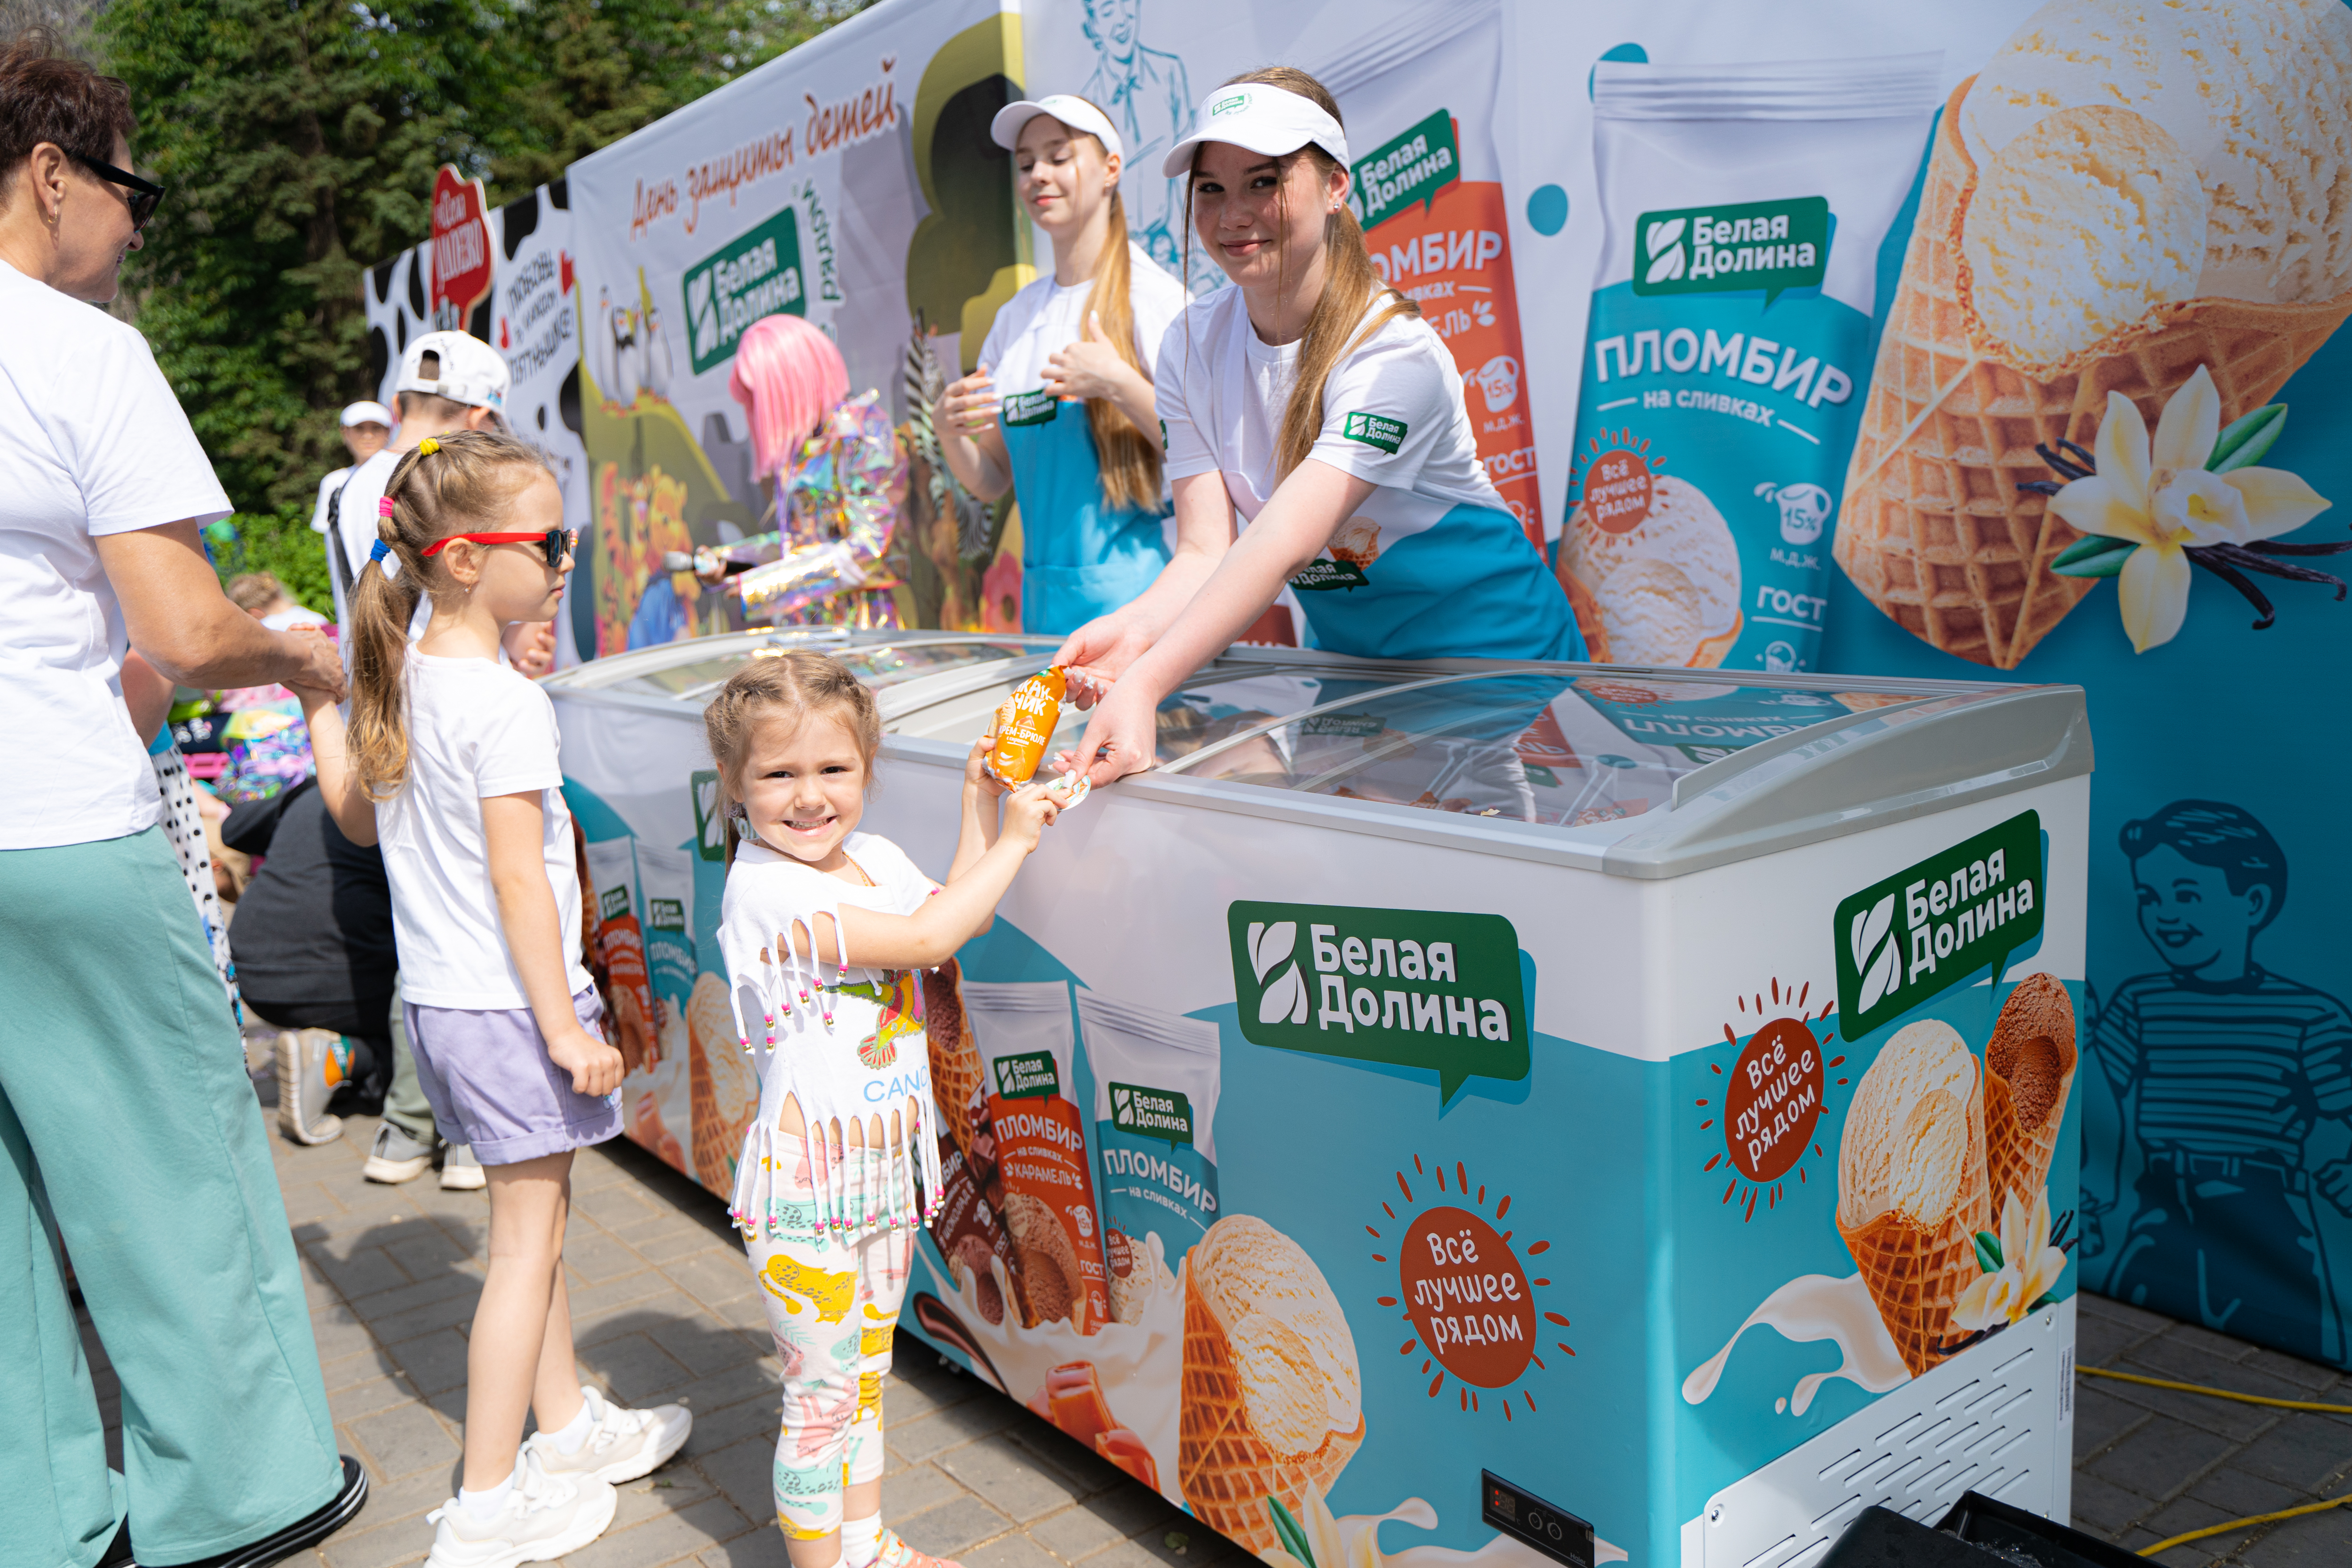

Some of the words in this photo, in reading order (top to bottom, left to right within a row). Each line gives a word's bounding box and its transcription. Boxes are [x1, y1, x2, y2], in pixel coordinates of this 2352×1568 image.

[631, 177, 678, 242] День
[684, 126, 795, 235] защиты
[804, 57, 896, 156] детей
[1359, 134, 1428, 189] Белая
[1365, 146, 1453, 218] Долина
[1693, 215, 1789, 246] Белая
[713, 236, 778, 300] Белая
[1369, 229, 1503, 282] ОМБИР
[1689, 242, 1816, 281] Долина
[717, 266, 801, 346] Долина
[1403, 280, 1455, 302] вках
[1594, 327, 1853, 408] ПЛОМБИР
[1486, 381, 1513, 400] 15%
[1367, 416, 1400, 434] Белая
[1644, 389, 1672, 409] на
[1676, 389, 1776, 428] сливках
[1366, 427, 1402, 445] Долина
[1482, 445, 1536, 478] ГОСТ
[1601, 458, 1630, 482] Всё
[1589, 475, 1648, 504] лучшее
[1596, 494, 1646, 524] рядом
[1785, 506, 1818, 532] 15%
[1299, 572, 1358, 586] Долина
[1306, 563, 1337, 574] елая
[1756, 585, 1828, 621] ГОСТ
[1012, 679, 1055, 701] АКАН-
[1015, 693, 1047, 716] ЧИК
[998, 724, 1046, 746] КРЕМ-БРЮЛЕ
[1009, 736, 1030, 746] сиропом
[1905, 848, 2007, 931] Белая
[1908, 878, 2035, 985] Долина
[1310, 923, 1457, 983] Белая
[1318, 974, 1512, 1042] Долина
[1011, 1058, 1044, 1075] Белая
[1746, 1035, 1787, 1090] Всё
[864, 1065, 932, 1102] CANC
[1015, 1072, 1056, 1092] Долина
[1735, 1049, 1815, 1140] лучшее
[1133, 1090, 1175, 1114] Белая
[994, 1113, 1083, 1153] ПЛОМБИР
[1136, 1108, 1189, 1133] Долина
[1748, 1084, 1815, 1172] рядом
[1017, 1146, 1028, 1157] на
[1028, 1146, 1063, 1164] сливках
[1014, 1162, 1072, 1186] КАРАМЕЛЬ
[1103, 1148, 1217, 1213] ПЛОМБИР
[942, 1188, 972, 1241] ШОКОЛАД
[1128, 1186, 1142, 1199] на
[1143, 1188, 1188, 1219] сливках
[1108, 1233, 1120, 1246] Всё
[1427, 1229, 1479, 1266] Всё
[1080, 1259, 1104, 1277] ГОСТ
[1414, 1272, 1521, 1312] лучшее
[1430, 1314, 1523, 1354] рядом
[1570, 1552, 1586, 1565] Haier
